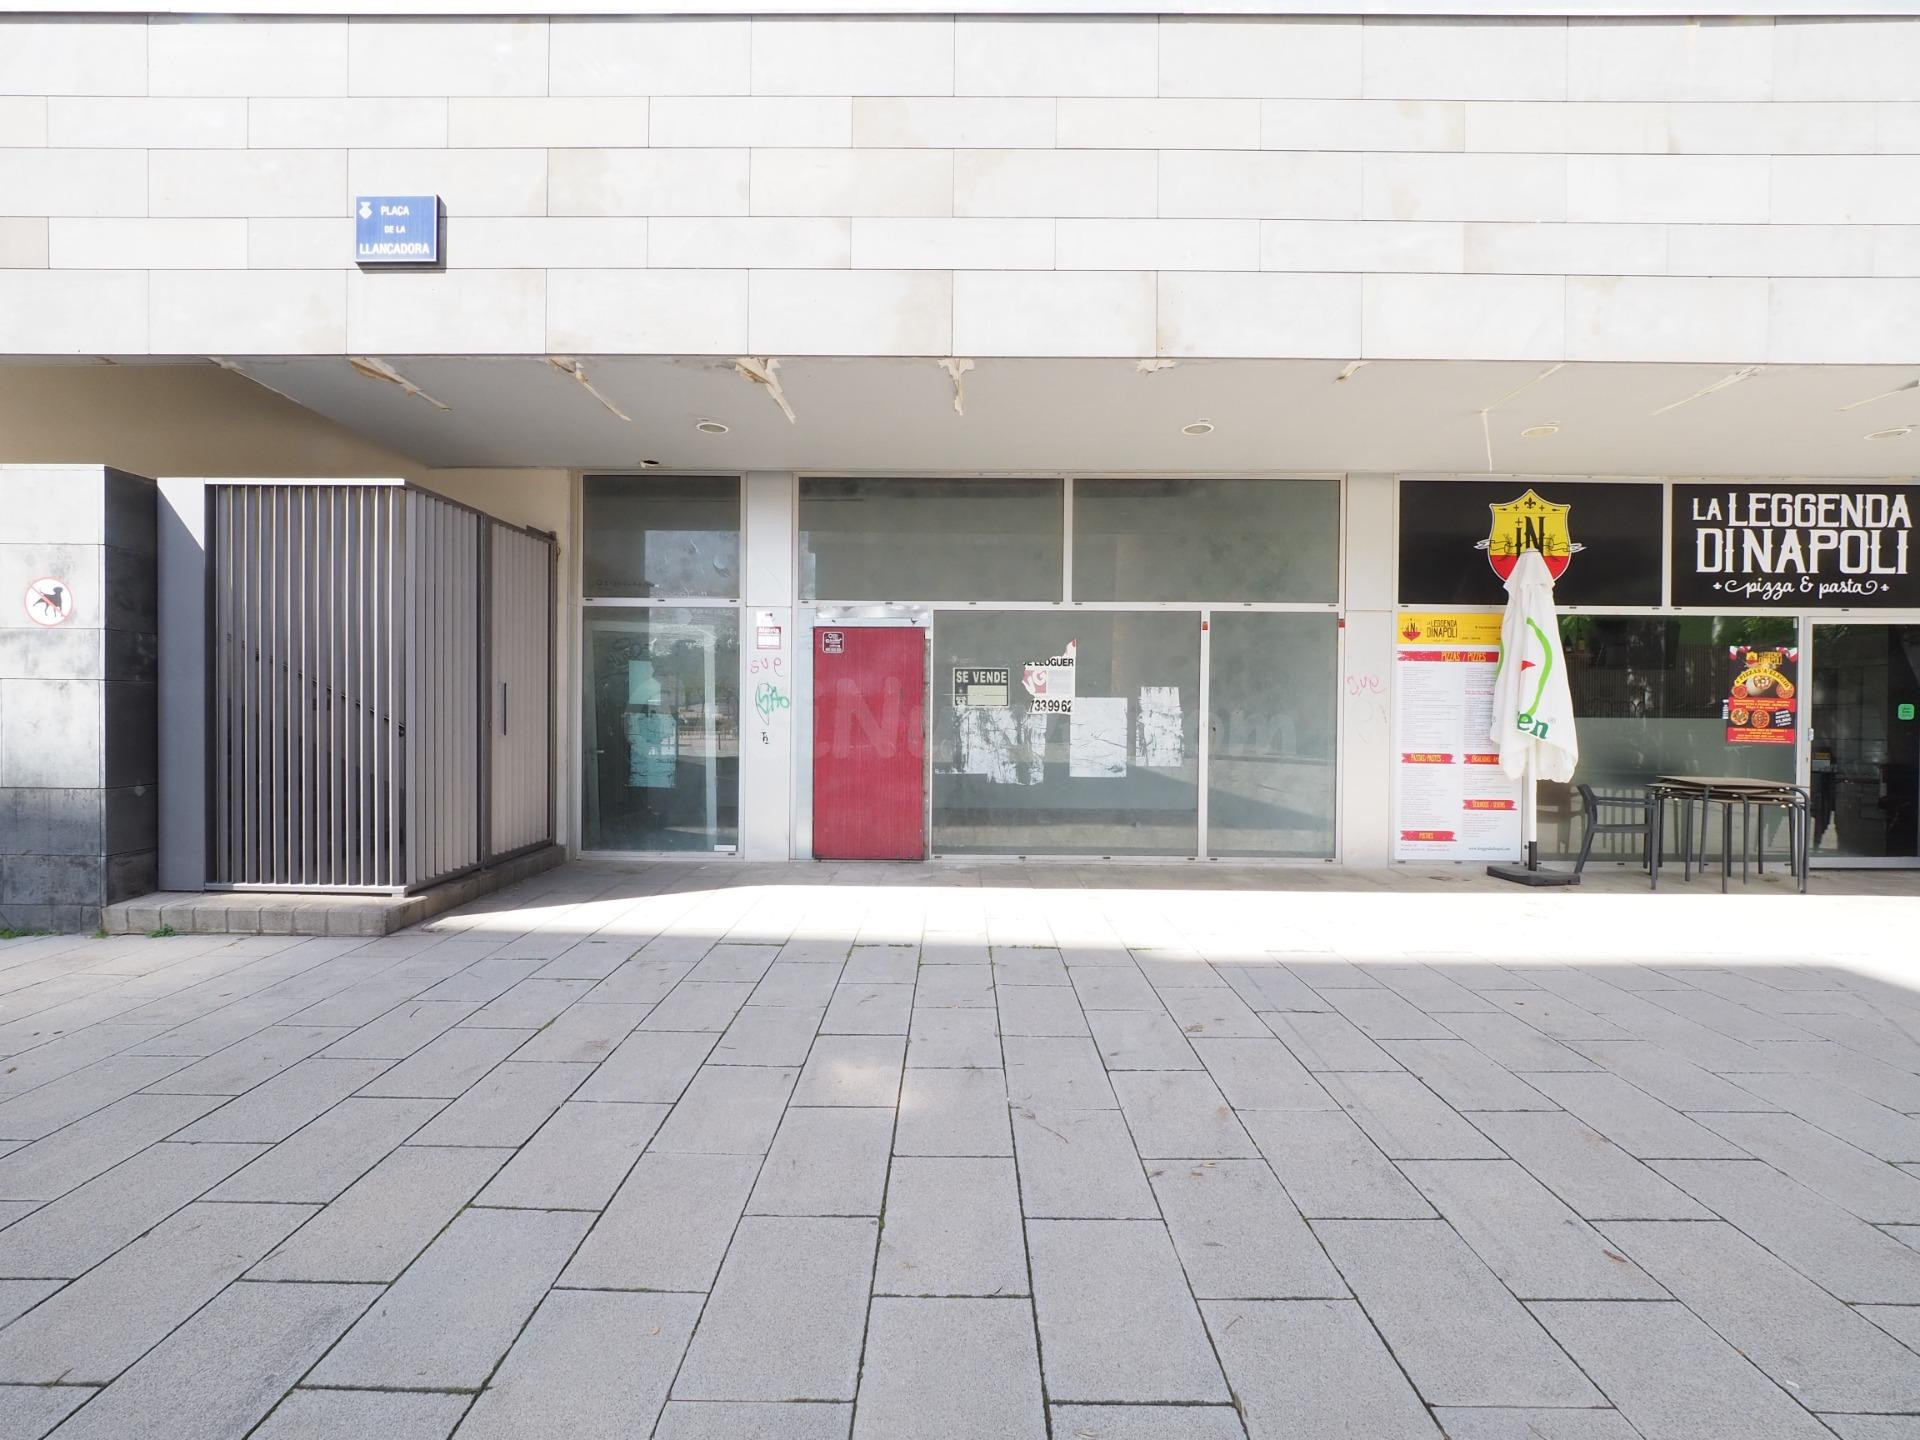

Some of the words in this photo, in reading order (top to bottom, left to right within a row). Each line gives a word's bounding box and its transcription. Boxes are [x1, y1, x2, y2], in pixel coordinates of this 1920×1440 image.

[381, 205, 410, 217] PLAÇA
[384, 225, 394, 234] DE
[396, 225, 406, 234] LA
[1692, 498, 1722, 521] LA
[1728, 492, 1912, 528] LEGGENDA
[1728, 577, 1795, 600] pizza
[1800, 576, 1813, 593] &
[1818, 578, 1877, 599] pasta
[956, 671, 969, 683] SE
[973, 671, 1007, 684] VENDE
